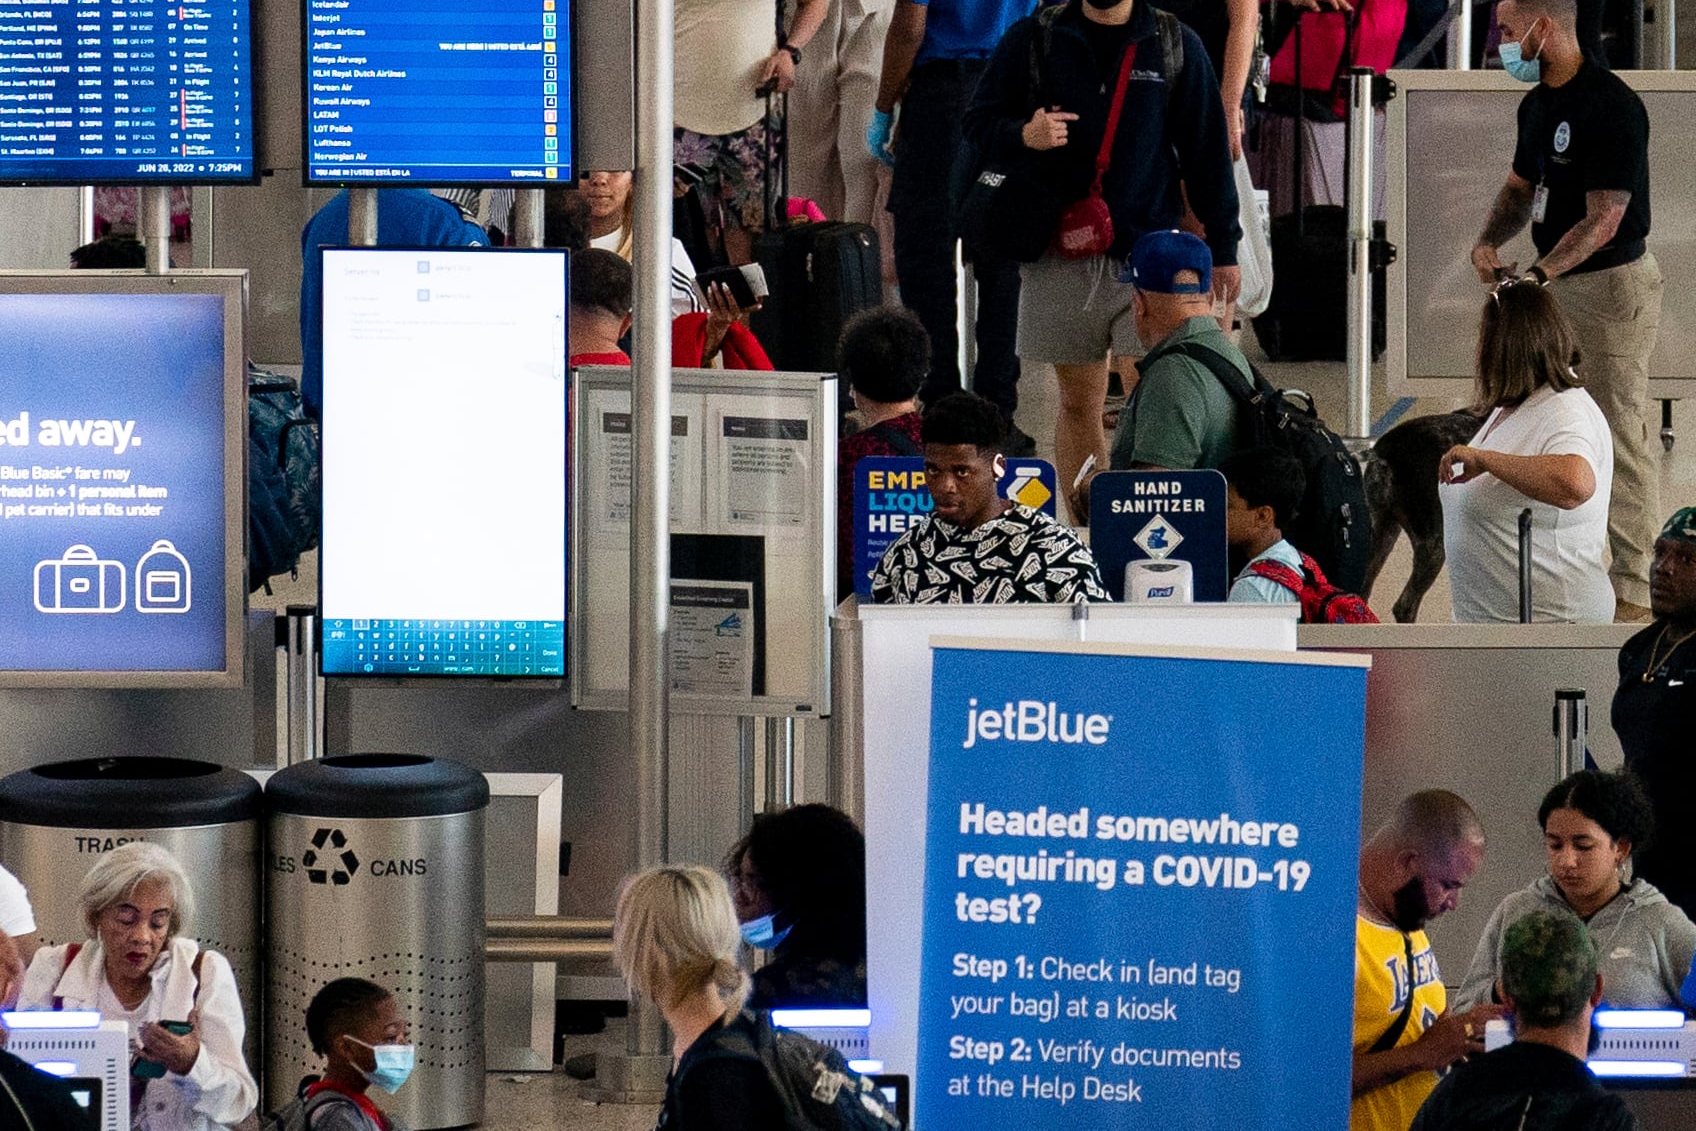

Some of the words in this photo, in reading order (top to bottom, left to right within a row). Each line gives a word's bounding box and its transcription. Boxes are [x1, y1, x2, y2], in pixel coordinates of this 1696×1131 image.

[336, 56, 367, 65] Airways
[354, 70, 375, 78] Dutch
[376, 70, 406, 78] Airlines
[340, 97, 370, 107] Airways
[137, 164, 156, 172] JUN
[173, 164, 194, 172] 2022
[208, 164, 242, 172] 7:25PM
[38, 419, 142, 454] away.
[0, 466, 29, 479] Blue
[75, 466, 101, 479] fare
[103, 469, 131, 482] may
[868, 471, 926, 490] EMP
[35, 484, 55, 498] bin
[68, 484, 76, 498] 1
[79, 484, 136, 500] personal
[138, 484, 168, 498] item
[1134, 481, 1182, 495] HAND
[5, 503, 26, 519] pet
[28, 502, 75, 517] carrier)
[77, 503, 101, 516] that
[103, 503, 124, 516] fits
[126, 503, 164, 516] under
[868, 492, 935, 514] LIQU
[1111, 499, 1205, 513] SANITIZER
[963, 698, 1112, 748] jetBlue
[959, 802, 1089, 839] Headed
[1095, 813, 1299, 848] somewhere
[370, 859, 427, 877] CANS
[957, 849, 1117, 890] requiring
[1124, 862, 1144, 885] a
[1153, 854, 1311, 892] COVID-19
[955, 892, 1042, 924] test?
[952, 952, 1008, 983] Step
[1014, 955, 1034, 979] 1:
[1040, 956, 1113, 982] Check
[1119, 959, 1140, 983] in
[1147, 958, 1197, 987] (and
[1204, 965, 1241, 993] tag
[950, 993, 1005, 1019] your
[1010, 991, 1060, 1023] bag)
[1066, 996, 1088, 1018] at
[1095, 1001, 1109, 1019] a
[1116, 995, 1178, 1021] kiosk
[949, 1035, 1004, 1065] Step
[1010, 1037, 1032, 1061] 2:
[1037, 1038, 1105, 1069] Verify
[1110, 1042, 1242, 1069] documents
[948, 1075, 970, 1096] at
[976, 1074, 1014, 1097] the
[1021, 1075, 1076, 1106] Help
[1083, 1077, 1142, 1103] Desk
